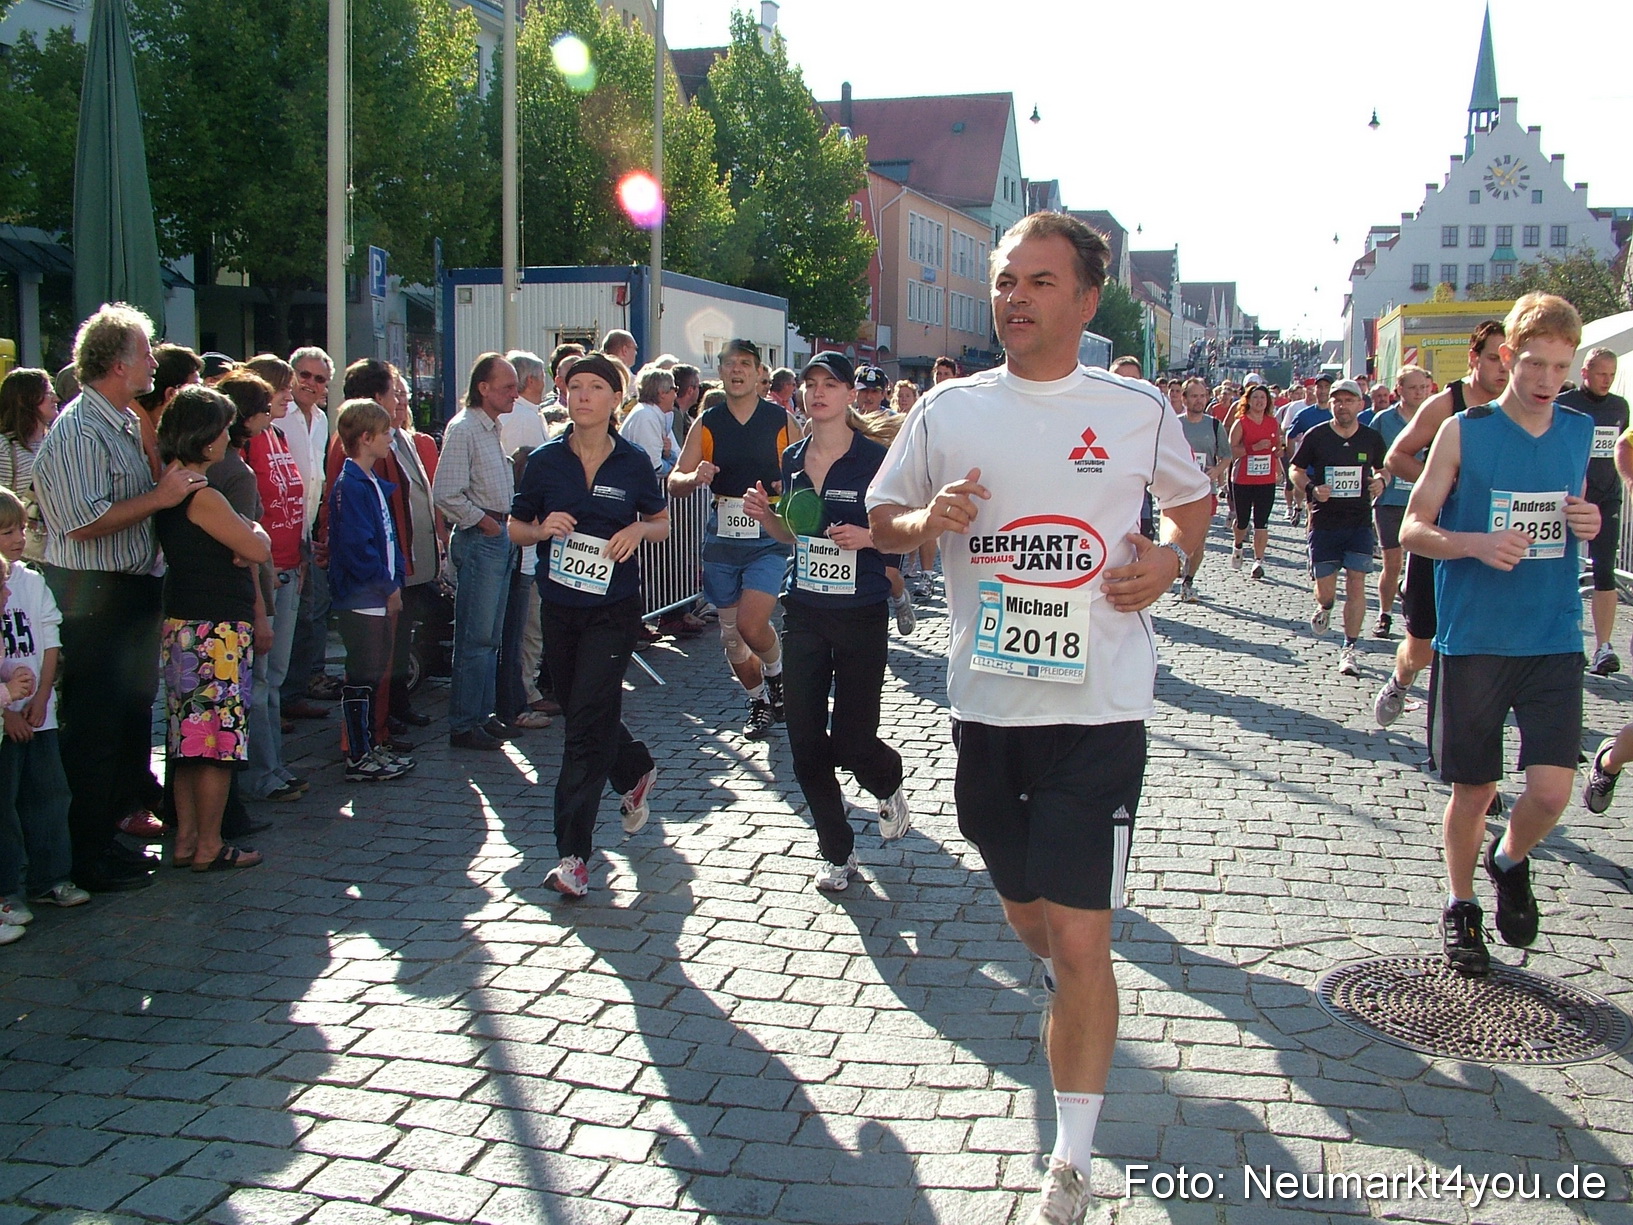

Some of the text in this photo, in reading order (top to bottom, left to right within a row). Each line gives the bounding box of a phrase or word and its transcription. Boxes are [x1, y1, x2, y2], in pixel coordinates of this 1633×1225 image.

[373, 253, 383, 290] P
[1335, 480, 1360, 490] 2079
[1512, 500, 1557, 512] Andreas
[727, 515, 756, 528] 3608
[1494, 516, 1504, 527] C
[566, 538, 600, 556] Andrea
[809, 543, 840, 556] Andrea
[969, 534, 1091, 554] GERHART &
[553, 549, 560, 559] D
[799, 555, 805, 565] C
[970, 552, 1093, 571] AUTOHAUS JÄNIG
[563, 556, 609, 581] 2042
[809, 561, 851, 580] 2628
[1006, 595, 1069, 618] Michael
[984, 616, 997, 631] D
[1004, 626, 1081, 659] 2018
[1039, 665, 1084, 678] PFLEIDERER
